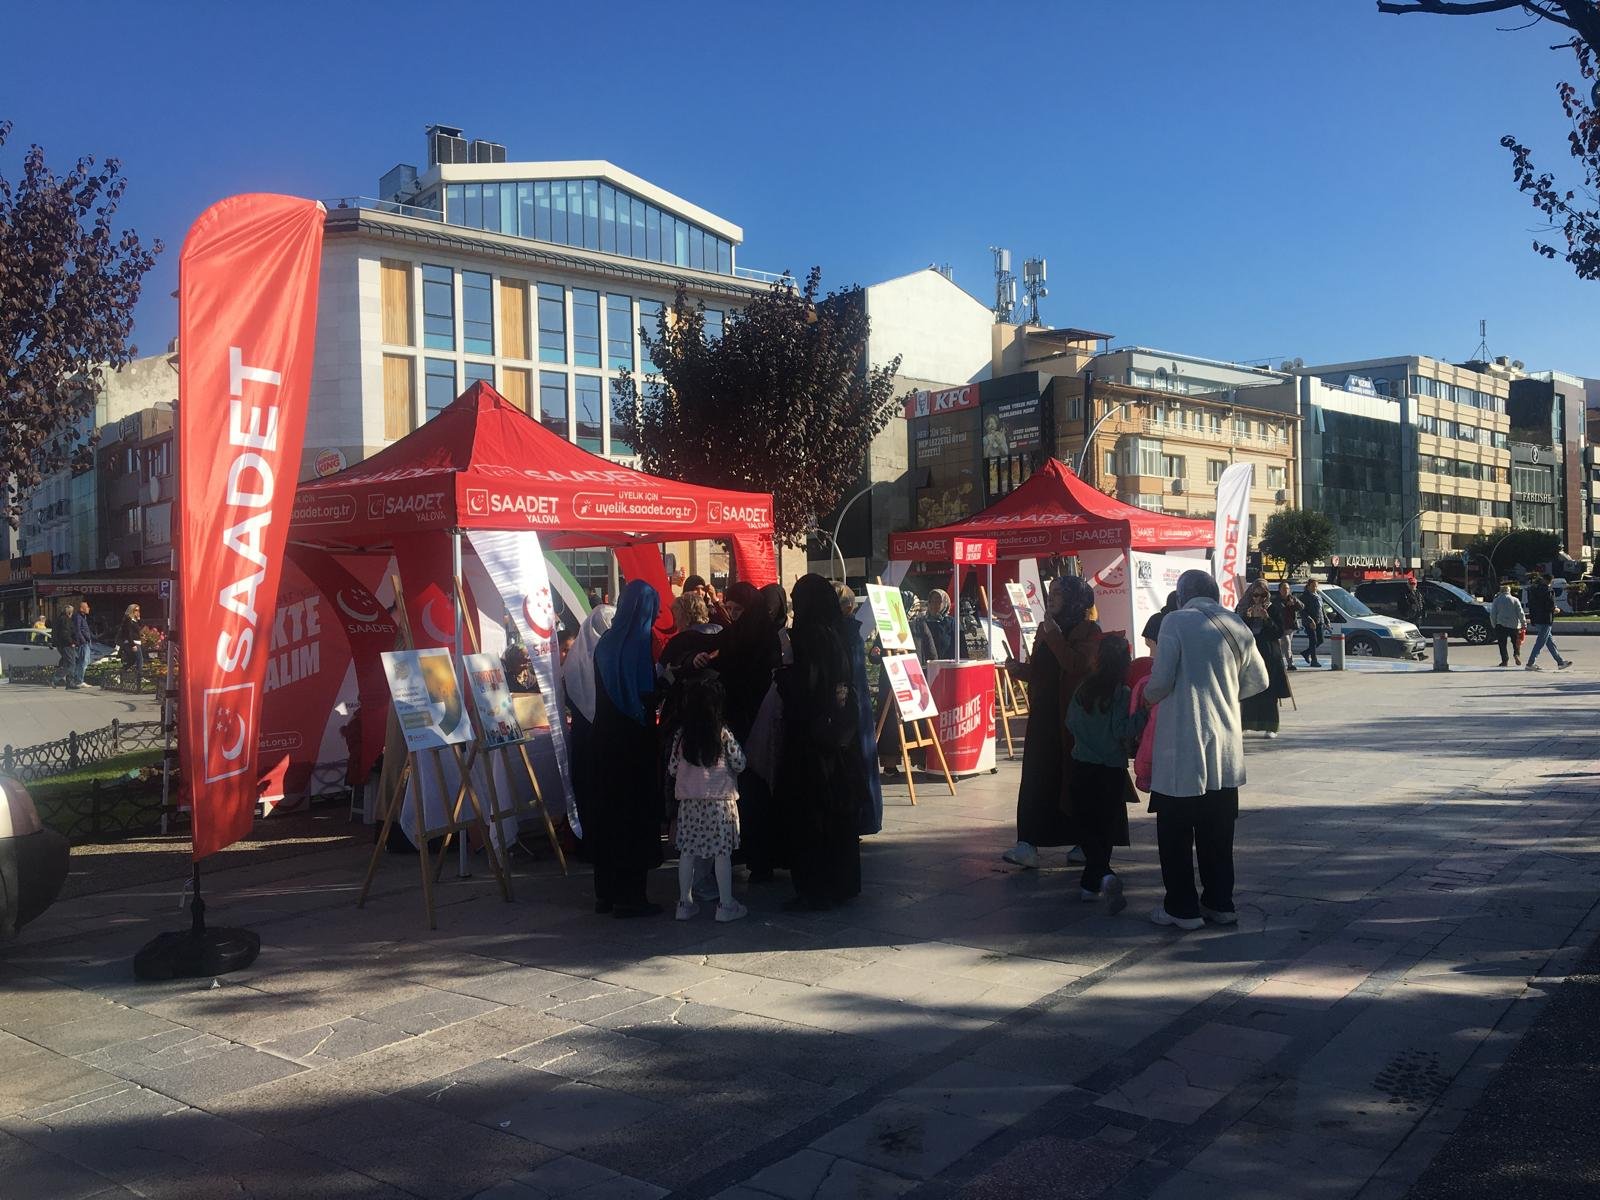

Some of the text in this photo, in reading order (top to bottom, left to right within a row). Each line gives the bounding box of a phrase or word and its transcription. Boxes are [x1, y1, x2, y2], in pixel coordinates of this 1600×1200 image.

[934, 388, 971, 411] KFC
[317, 460, 341, 473] KING
[216, 346, 282, 672] SAADET
[385, 493, 445, 514] SAADET
[490, 494, 560, 514] SAADET
[595, 501, 691, 519] uyelik.saadet.org.tr
[416, 510, 446, 522] YALOVA
[526, 514, 560, 524] YALOVA
[722, 506, 768, 522] SAADET
[1075, 528, 1122, 540] SAADET
[906, 540, 947, 551] SAADET
[1222, 514, 1240, 609] SAADET
[1375, 555, 1388, 570] AVM
[80, 585, 105, 594] OTEL
[116, 585, 138, 593] EFES
[347, 623, 395, 634] SAADET
